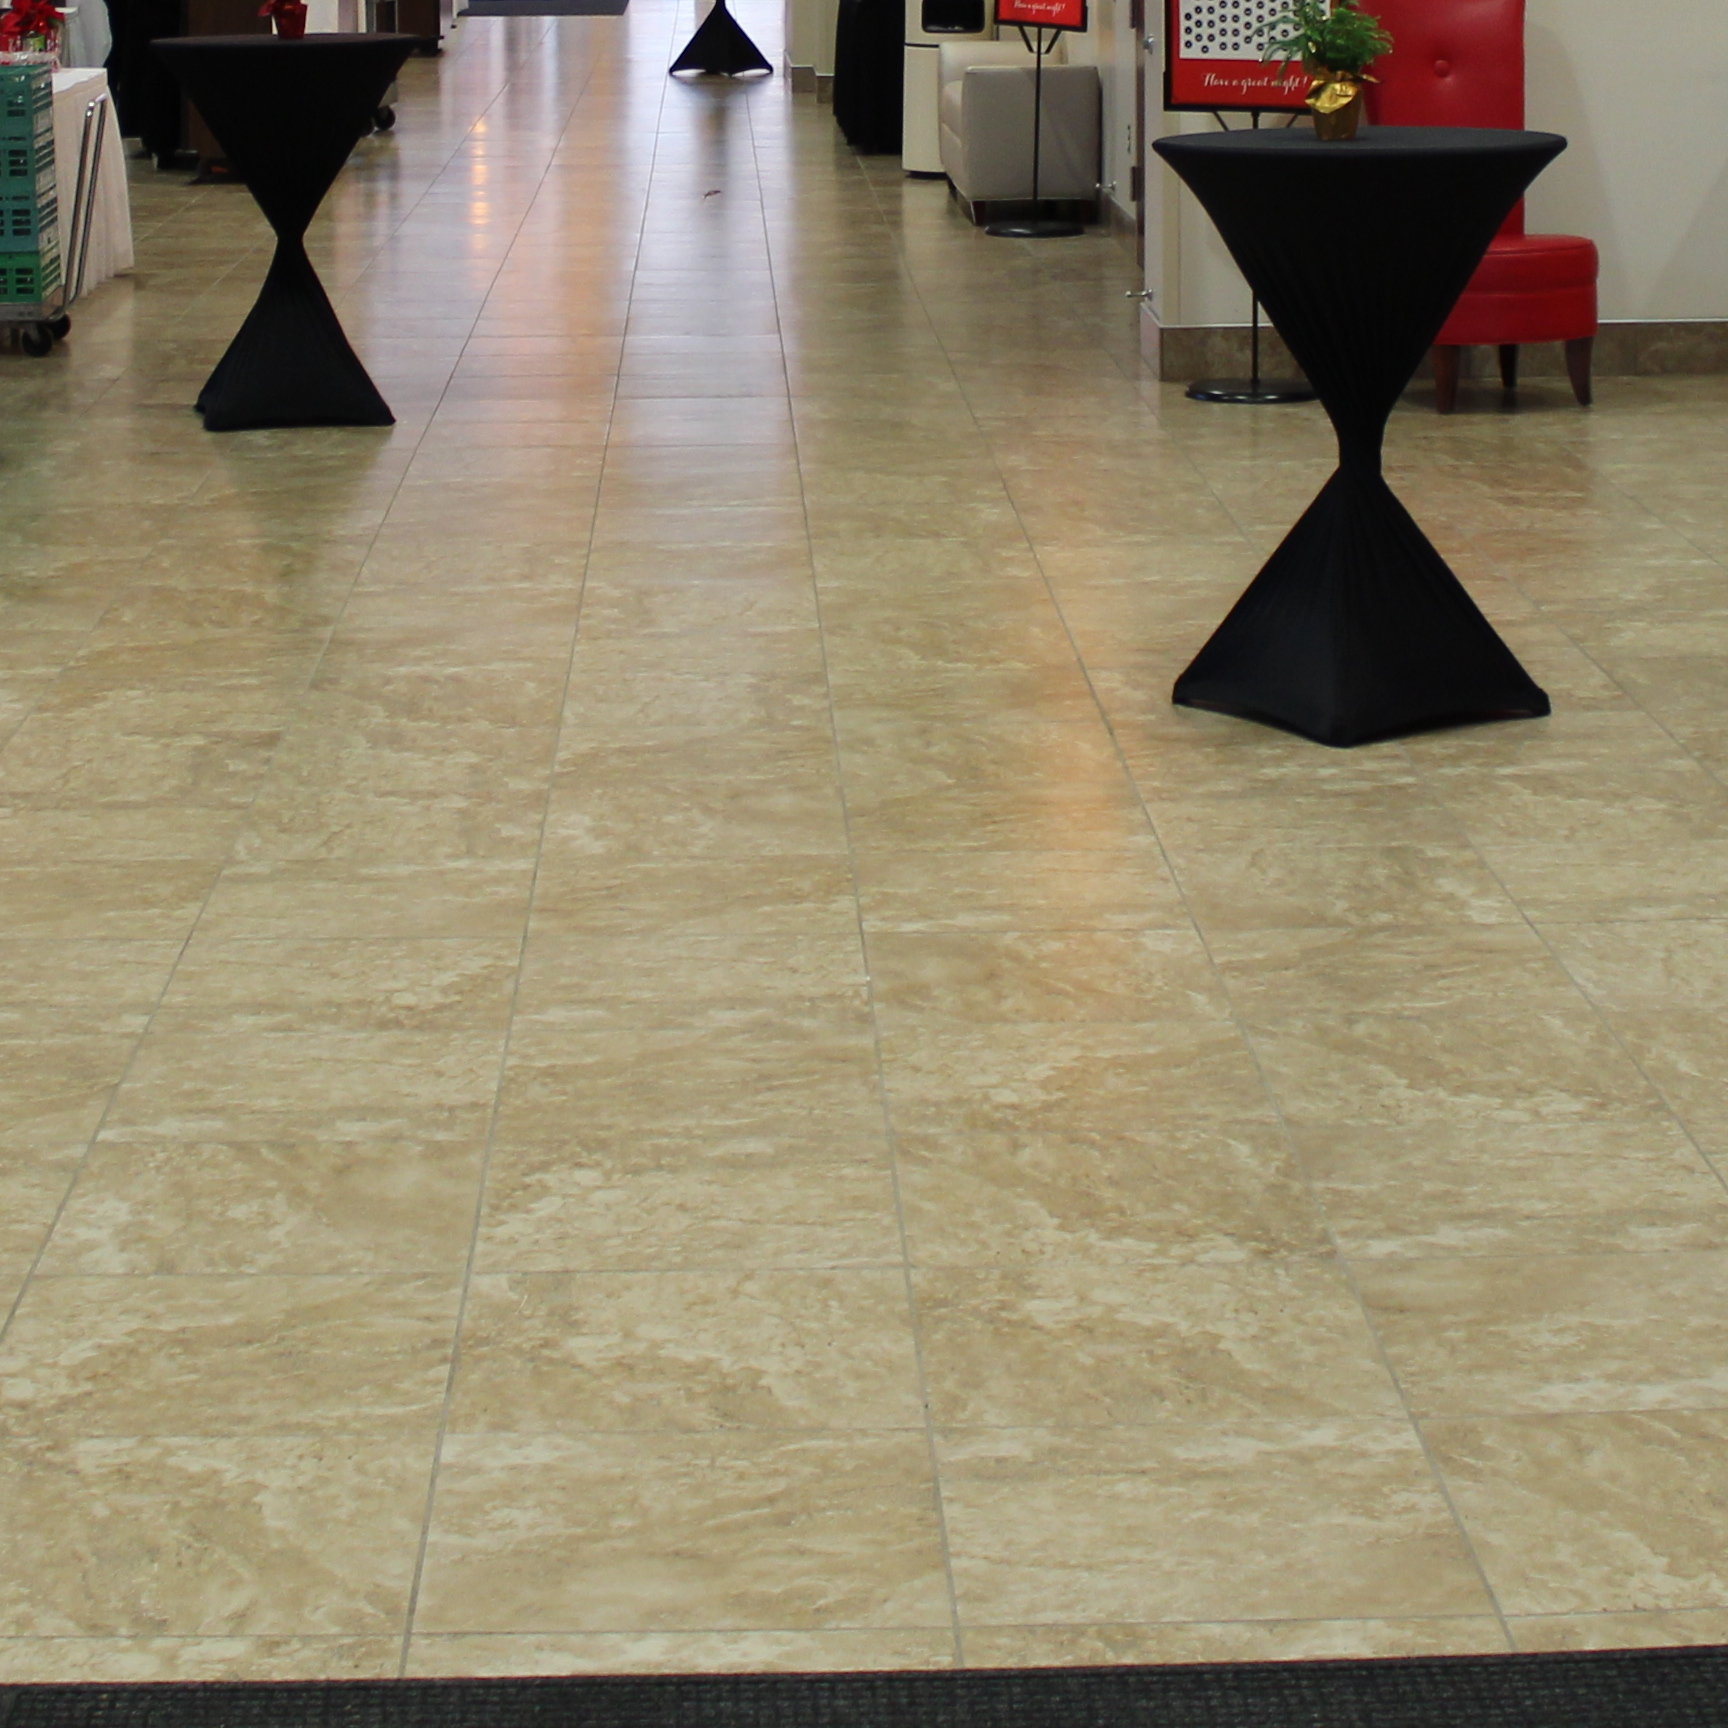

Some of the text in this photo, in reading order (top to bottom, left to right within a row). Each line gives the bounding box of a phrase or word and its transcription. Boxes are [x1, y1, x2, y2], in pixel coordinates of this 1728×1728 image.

[1204, 73, 1229, 87] Have
[1232, 79, 1239, 87] a
[1241, 76, 1269, 95] great
